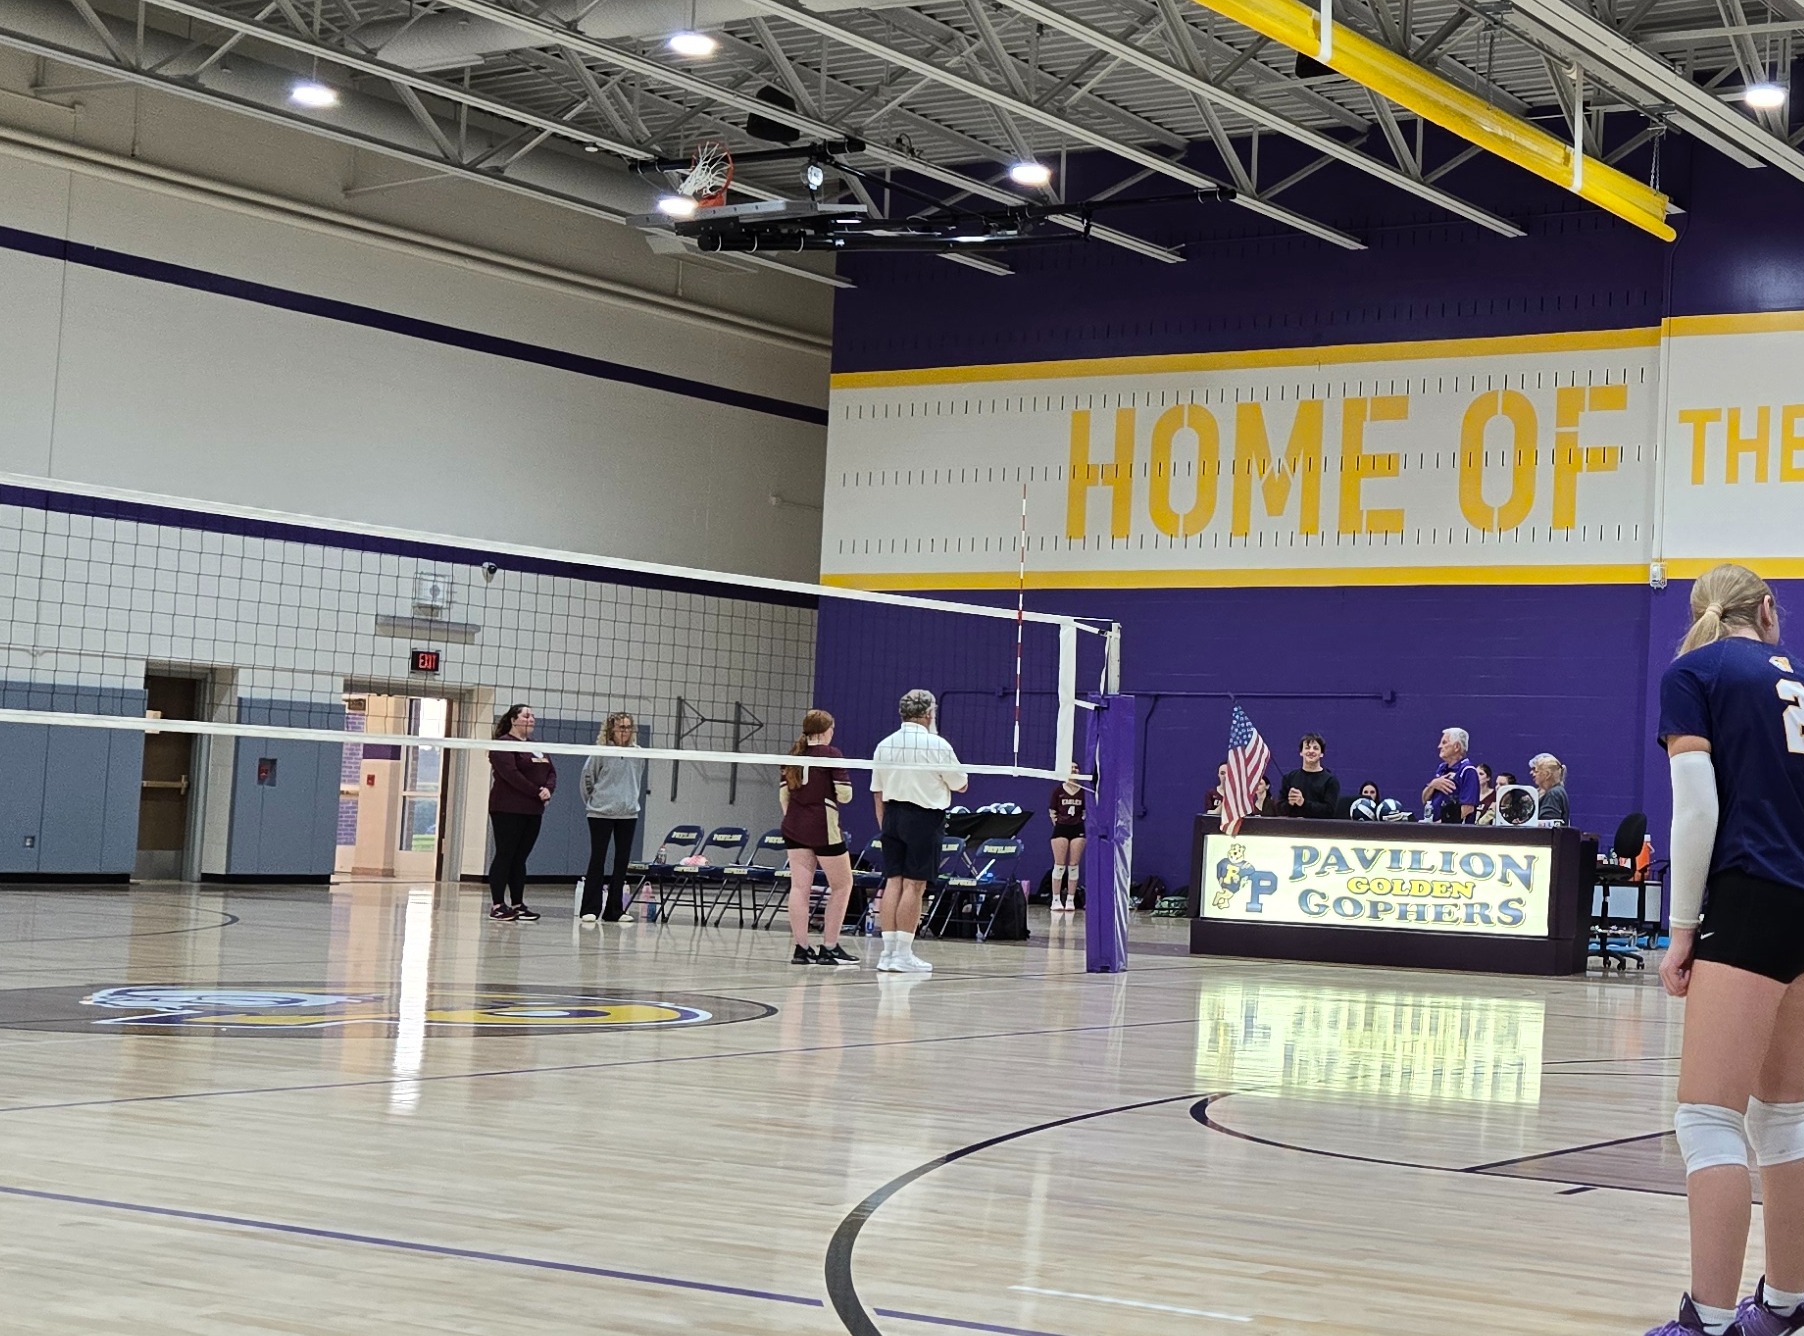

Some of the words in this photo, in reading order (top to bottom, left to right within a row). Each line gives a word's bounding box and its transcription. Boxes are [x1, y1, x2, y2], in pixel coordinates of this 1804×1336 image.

[1065, 395, 1410, 540] HOME
[1458, 383, 1628, 533] OF
[418, 652, 437, 669] EXIT
[1067, 805, 1076, 817] 4
[1288, 845, 1538, 893] PAVILION
[1346, 876, 1476, 899] GOLDEN
[1245, 870, 1279, 913] P
[1297, 888, 1527, 927] GOPHERS
